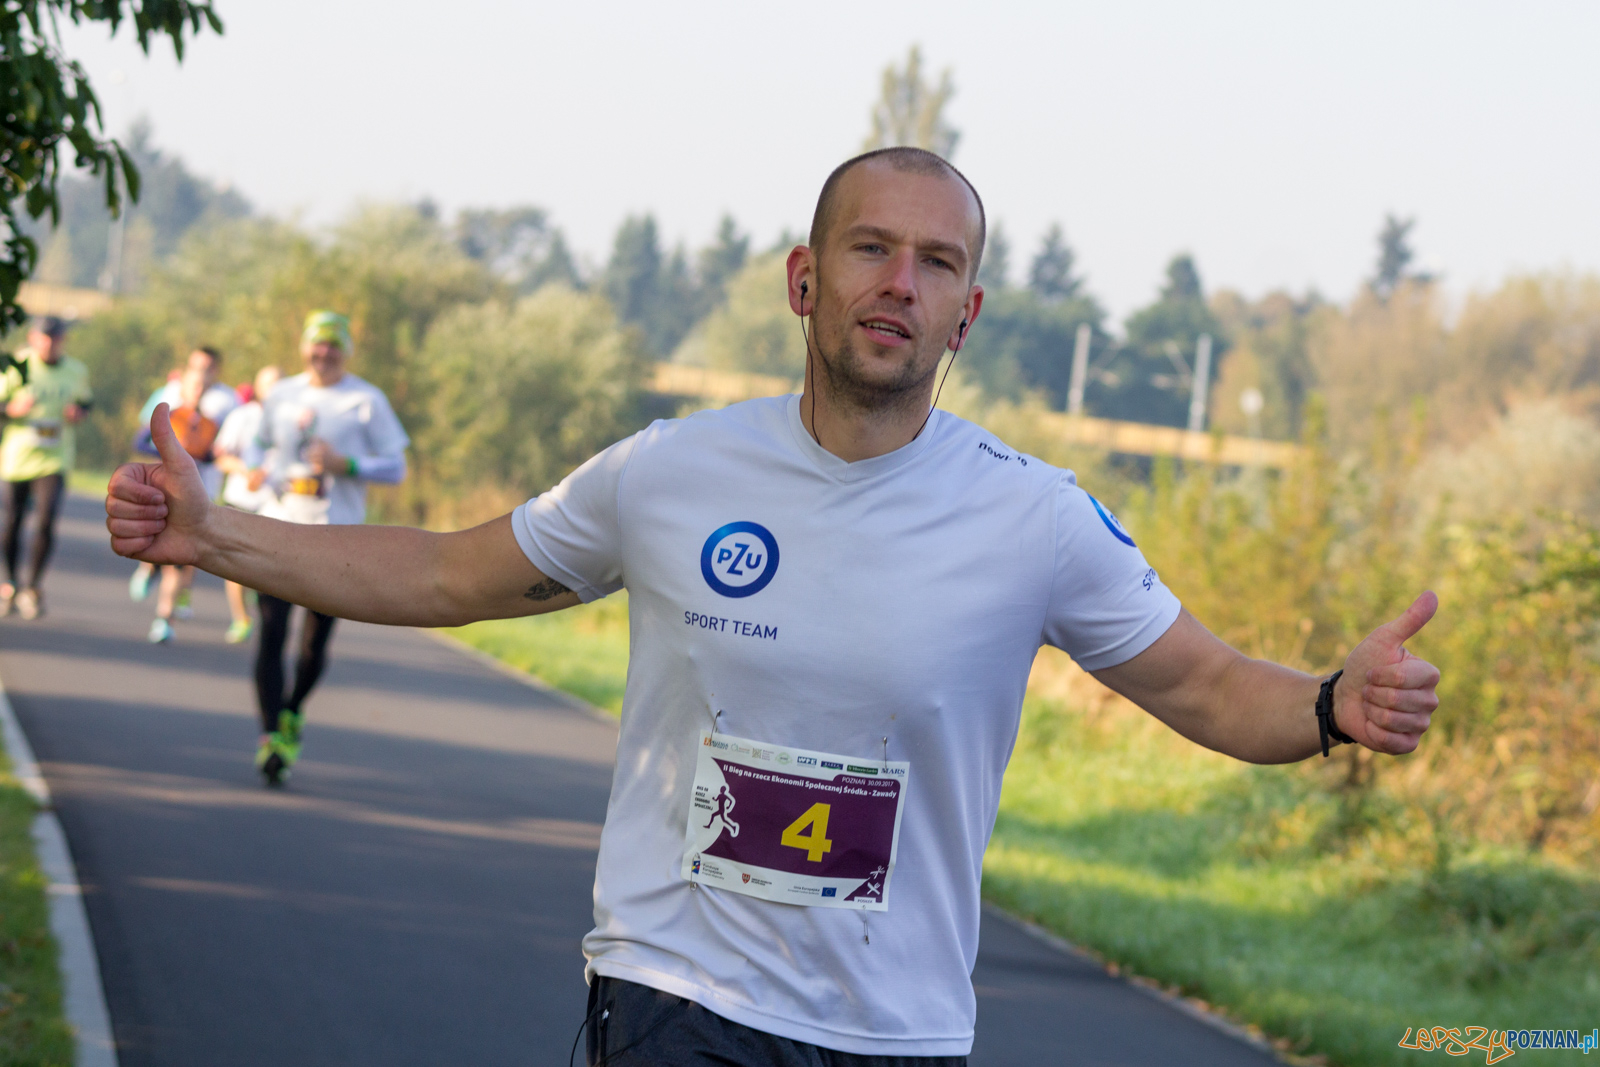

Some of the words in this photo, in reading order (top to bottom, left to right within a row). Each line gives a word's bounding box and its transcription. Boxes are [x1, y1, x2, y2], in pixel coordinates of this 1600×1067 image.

[717, 542, 762, 576] PZU
[684, 611, 728, 632] SPORT
[732, 620, 778, 640] TEAM
[728, 766, 742, 776] Bieg
[743, 770, 752, 778] na
[752, 773, 771, 781] rzecz
[771, 776, 804, 786] Ekonomii
[842, 785, 868, 796] Śródka
[872, 790, 897, 798] Zawady
[780, 802, 833, 863] 4
